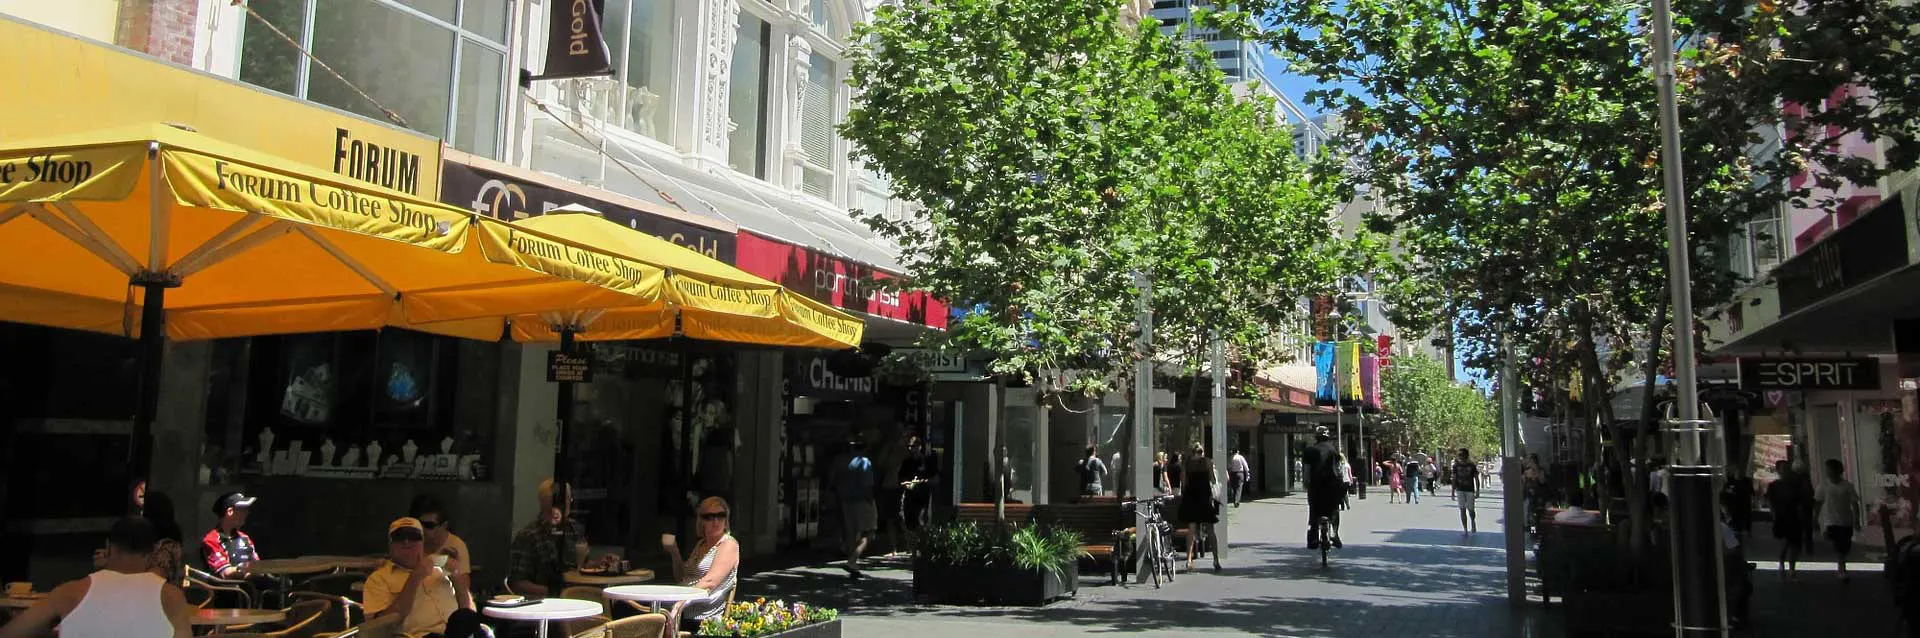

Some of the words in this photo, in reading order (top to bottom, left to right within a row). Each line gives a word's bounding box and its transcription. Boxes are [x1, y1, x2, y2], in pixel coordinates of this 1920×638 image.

[24, 154, 92, 189] Shop
[333, 127, 420, 196] FORUM
[310, 181, 381, 218] Coffee
[387, 198, 437, 236] Shop
[565, 246, 611, 274] Coffee
[612, 257, 642, 288] Shop
[744, 289, 771, 311] Shop
[1759, 361, 1859, 386] ESPRIT
